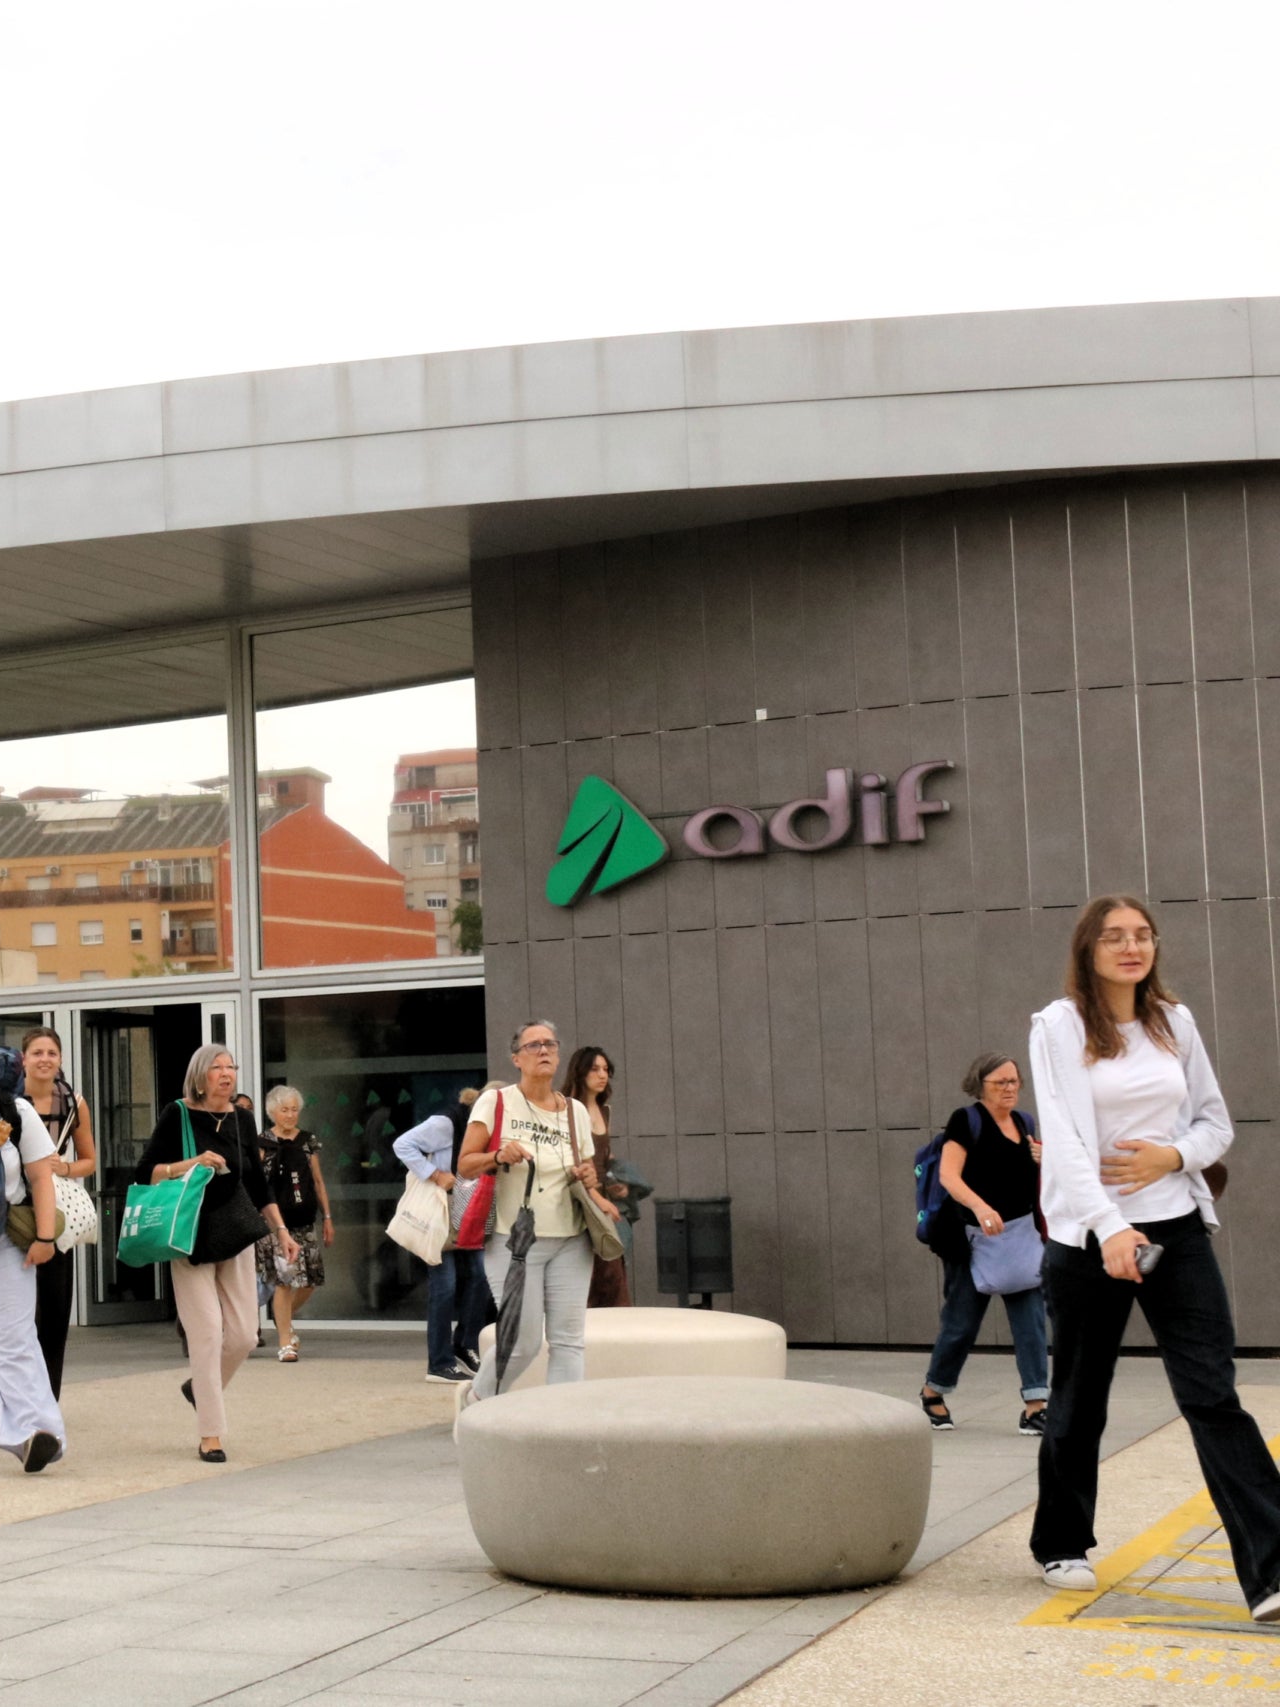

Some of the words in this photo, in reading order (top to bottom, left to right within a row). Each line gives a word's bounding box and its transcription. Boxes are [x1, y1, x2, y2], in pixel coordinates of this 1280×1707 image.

[683, 760, 955, 859] adif
[511, 1119, 549, 1135] DREAM
[1081, 1662, 1280, 1691] SALID
